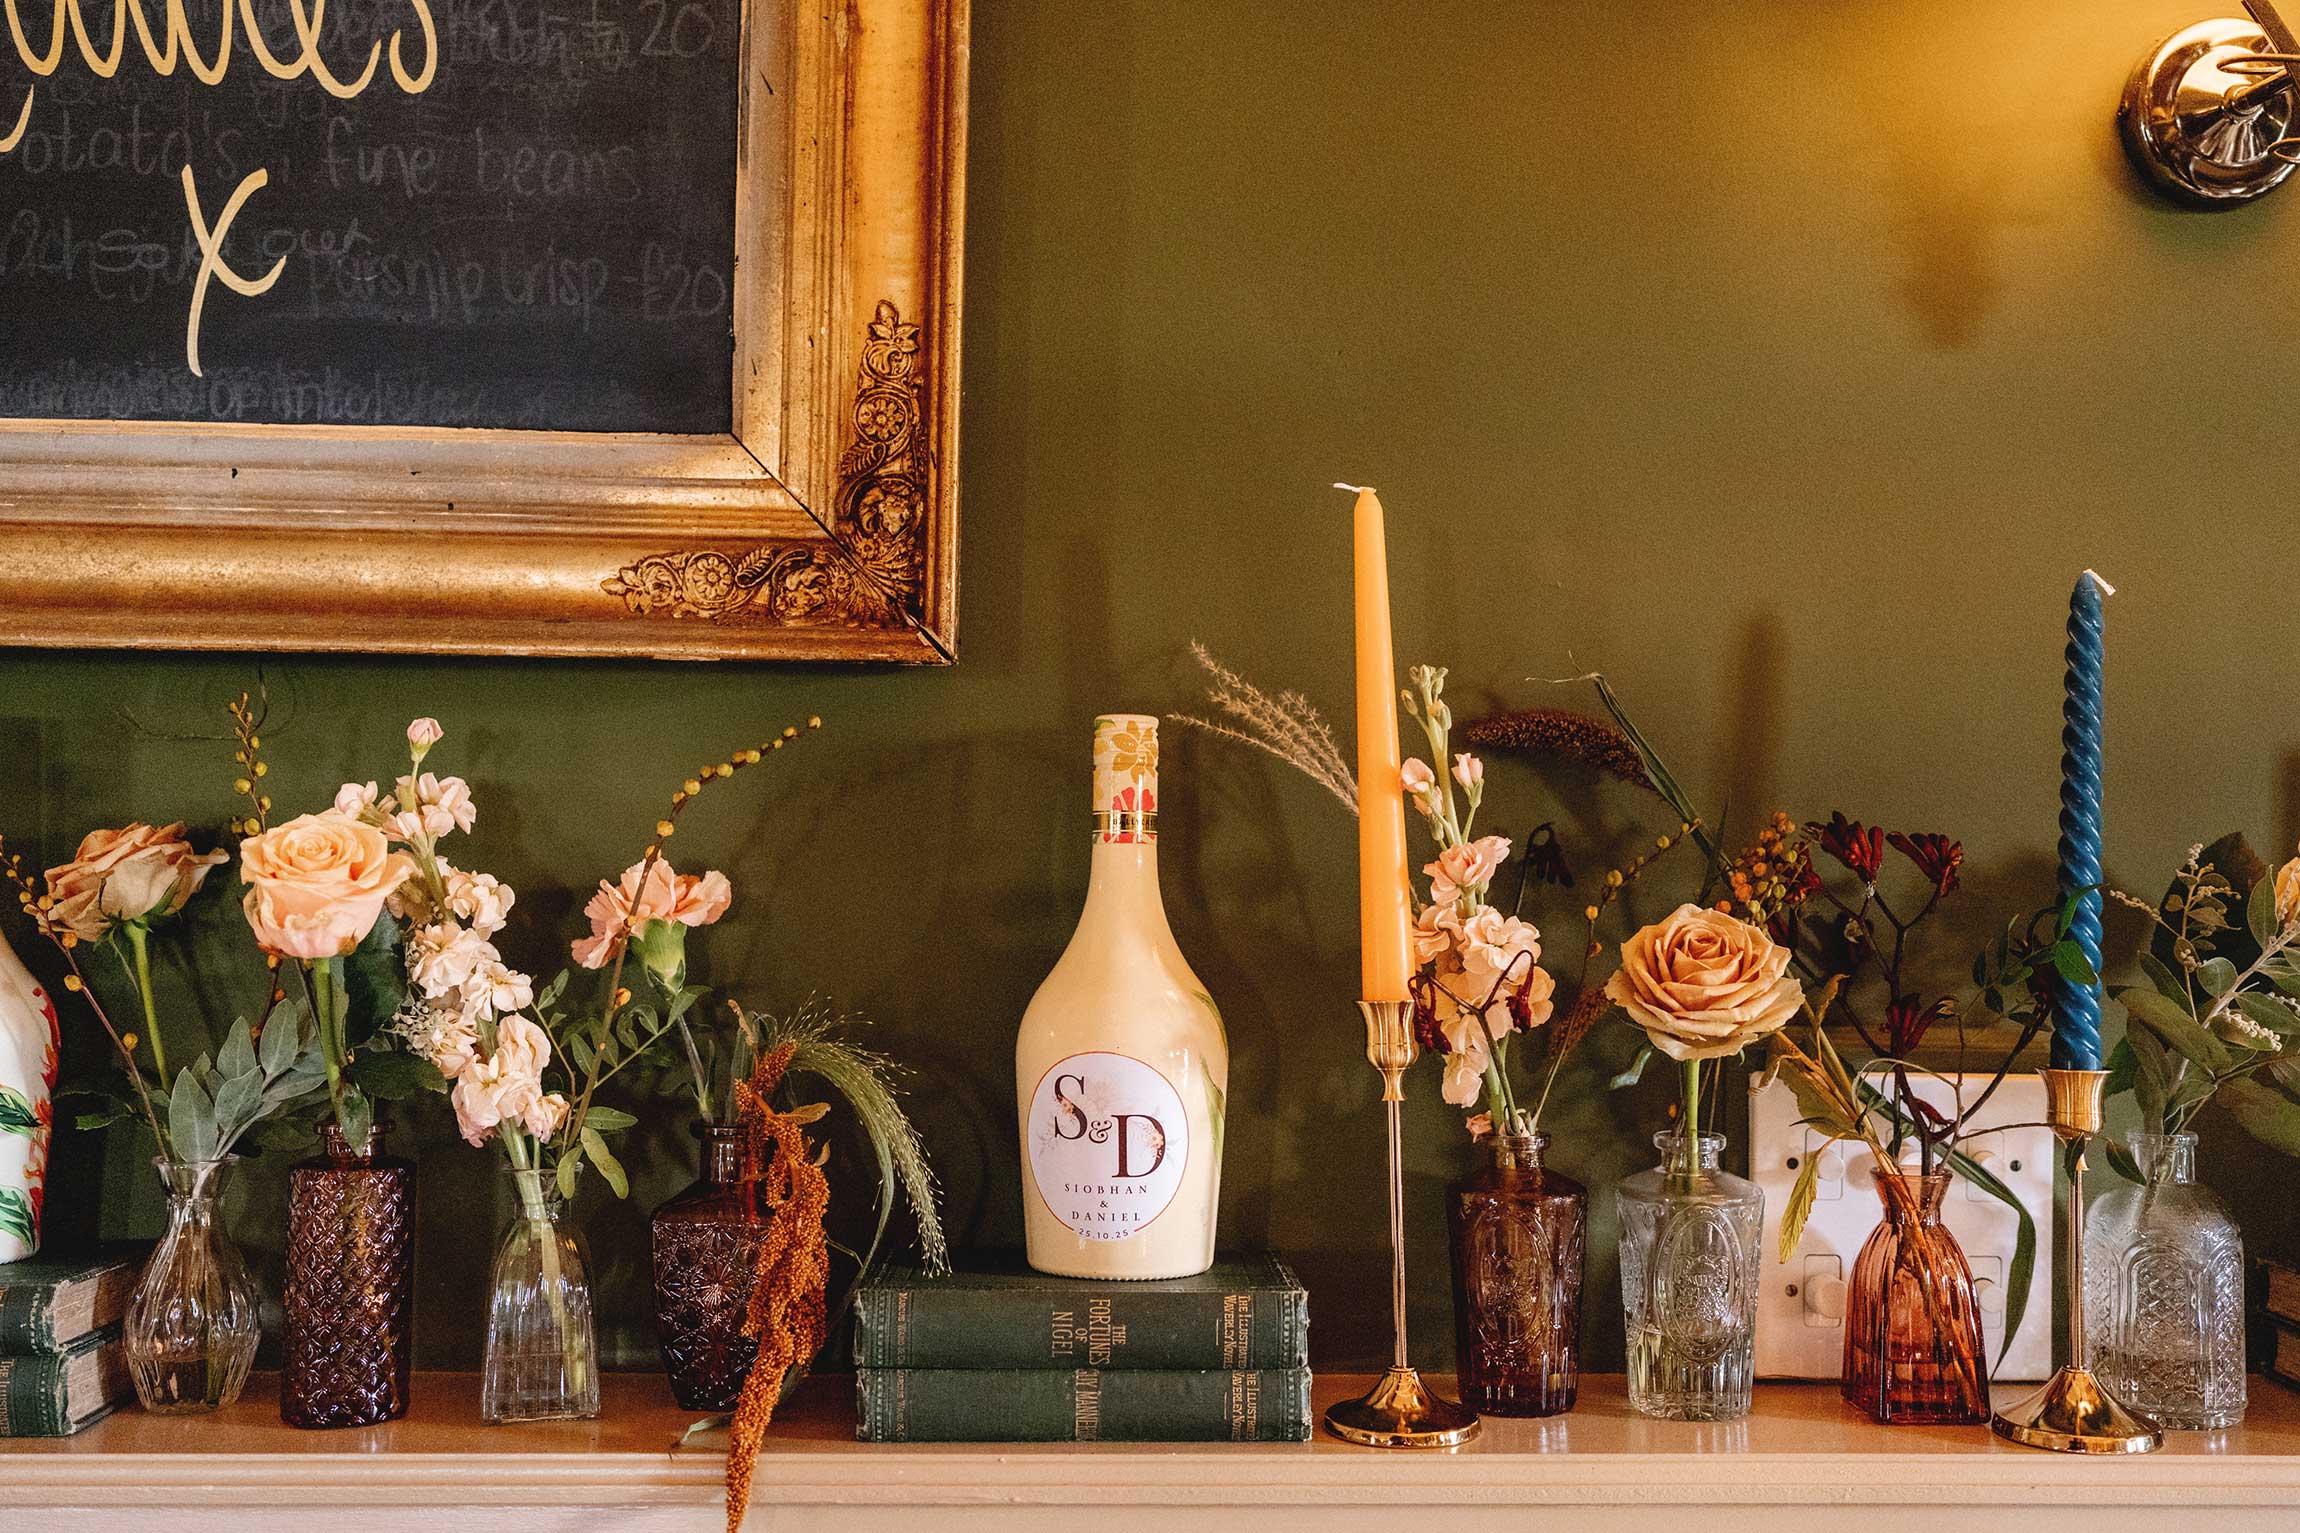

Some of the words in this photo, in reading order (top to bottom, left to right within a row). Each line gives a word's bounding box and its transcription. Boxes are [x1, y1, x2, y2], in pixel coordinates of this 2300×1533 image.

[475, 126, 641, 202] beans
[1064, 1183, 1148, 1195] SIOBHAN
[1099, 1200, 1109, 1208] &
[1072, 1211, 1141, 1222] DANIEL
[1079, 1227, 1129, 1240] 25.10.25
[1238, 1295, 1251, 1312] THE
[1224, 1295, 1237, 1341] WAVERLEY
[1052, 1312, 1073, 1358] NIGEL
[1075, 1328, 1088, 1343] OF
[1089, 1299, 1111, 1365] FORTUNES
[1112, 1324, 1126, 1345] THE
[1247, 1370, 1259, 1386] HE
